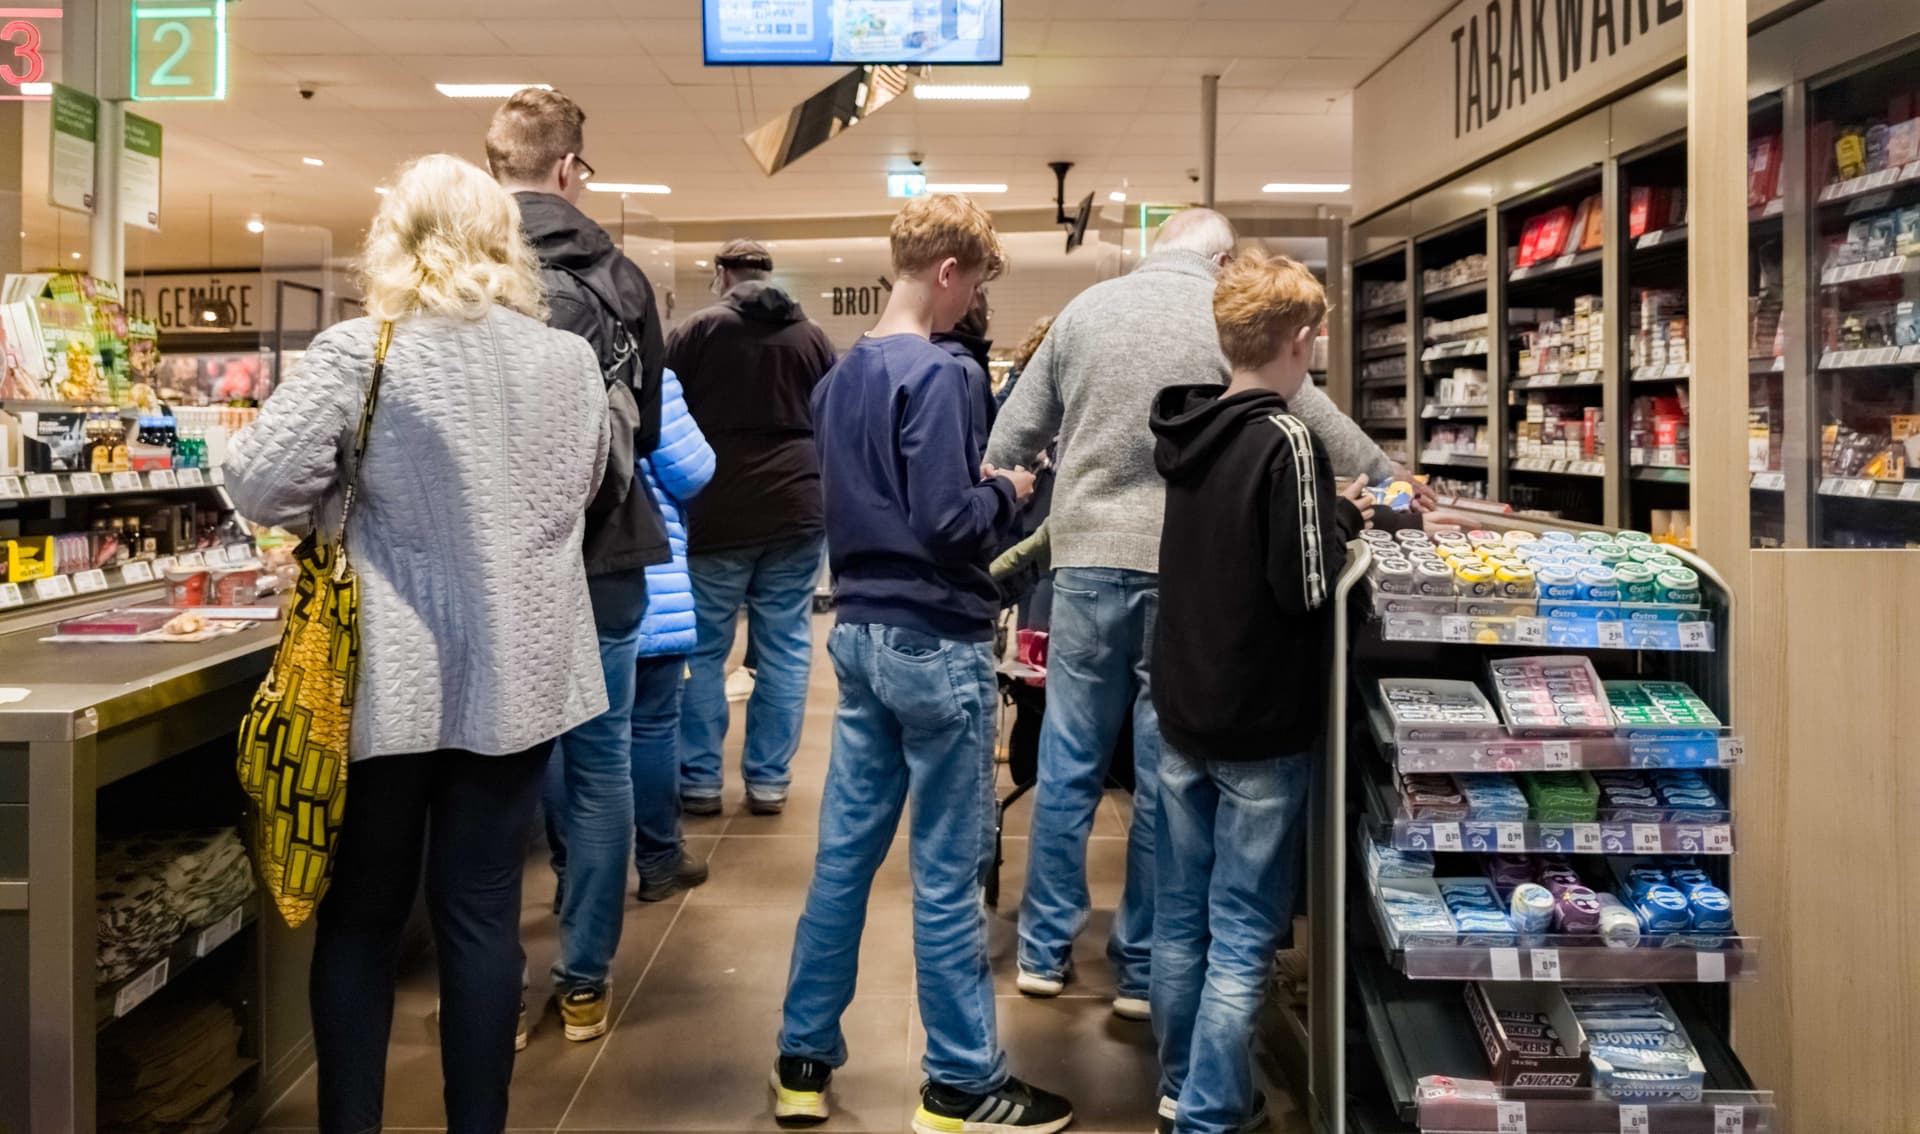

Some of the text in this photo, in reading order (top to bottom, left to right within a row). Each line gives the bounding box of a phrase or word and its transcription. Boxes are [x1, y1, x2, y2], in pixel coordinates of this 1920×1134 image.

[0, 20, 44, 86] 3
[151, 22, 192, 86] 2
[1451, 0, 1684, 139] TABAKW
[833, 286, 882, 316] BROT
[1514, 1073, 1579, 1087] SNICKERS
